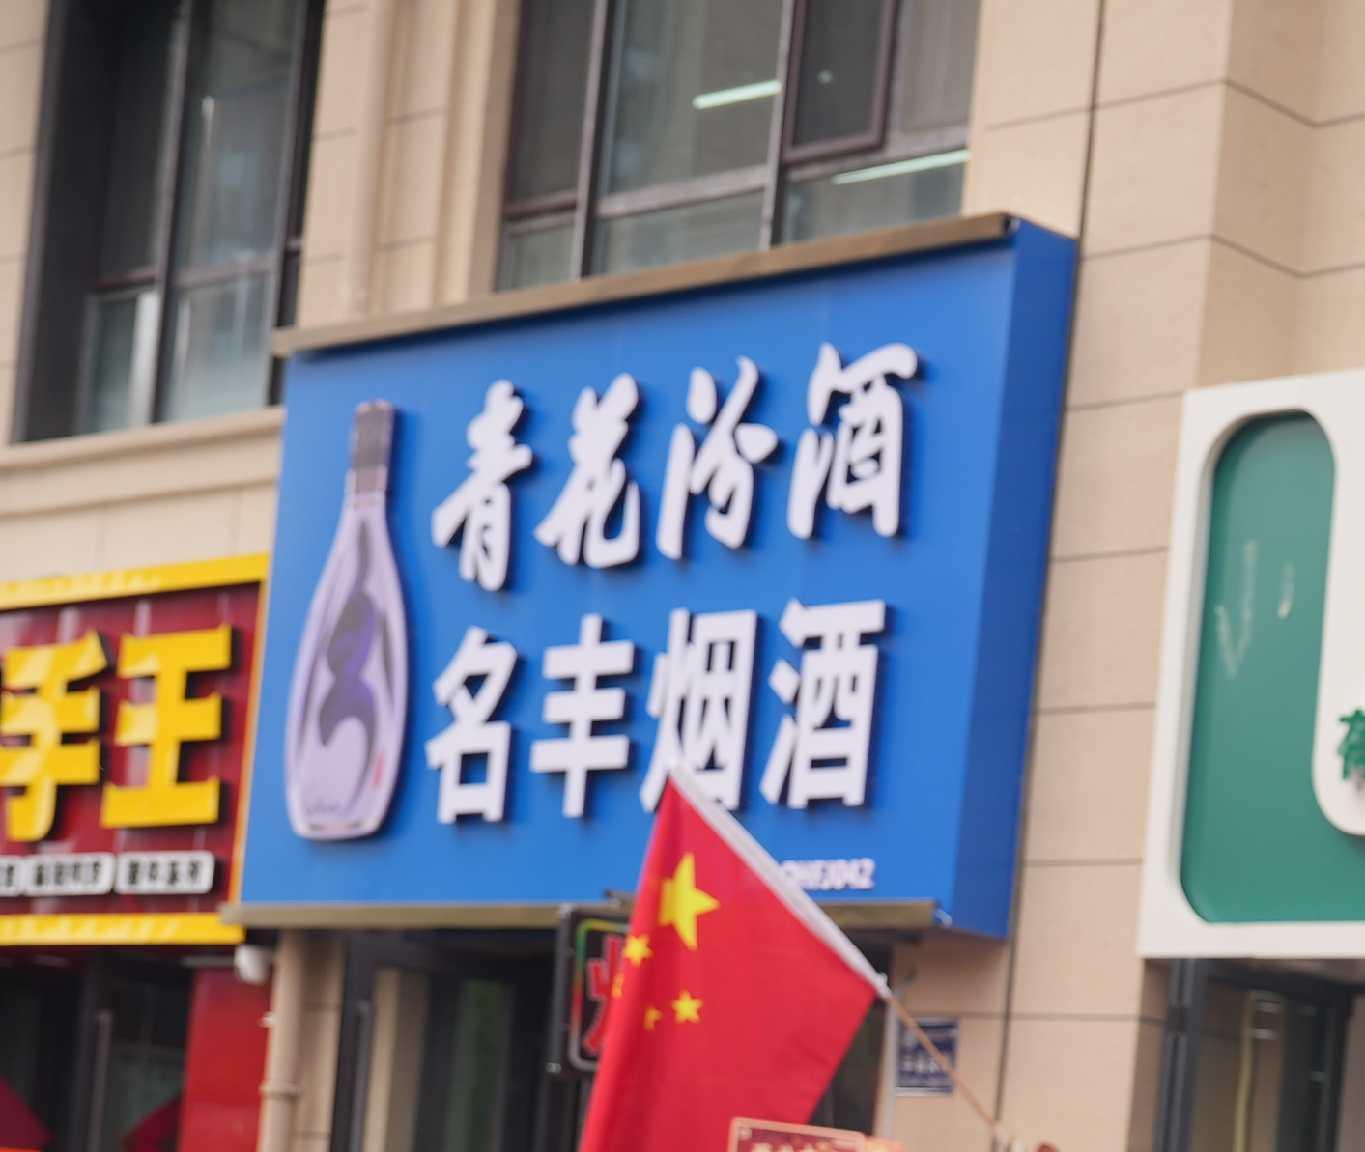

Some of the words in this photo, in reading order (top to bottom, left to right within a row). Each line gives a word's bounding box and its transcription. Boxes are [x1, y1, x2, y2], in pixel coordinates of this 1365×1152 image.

[430, 341, 921, 592] 青花汾酒
[424, 598, 887, 824] 名丰烟酒
